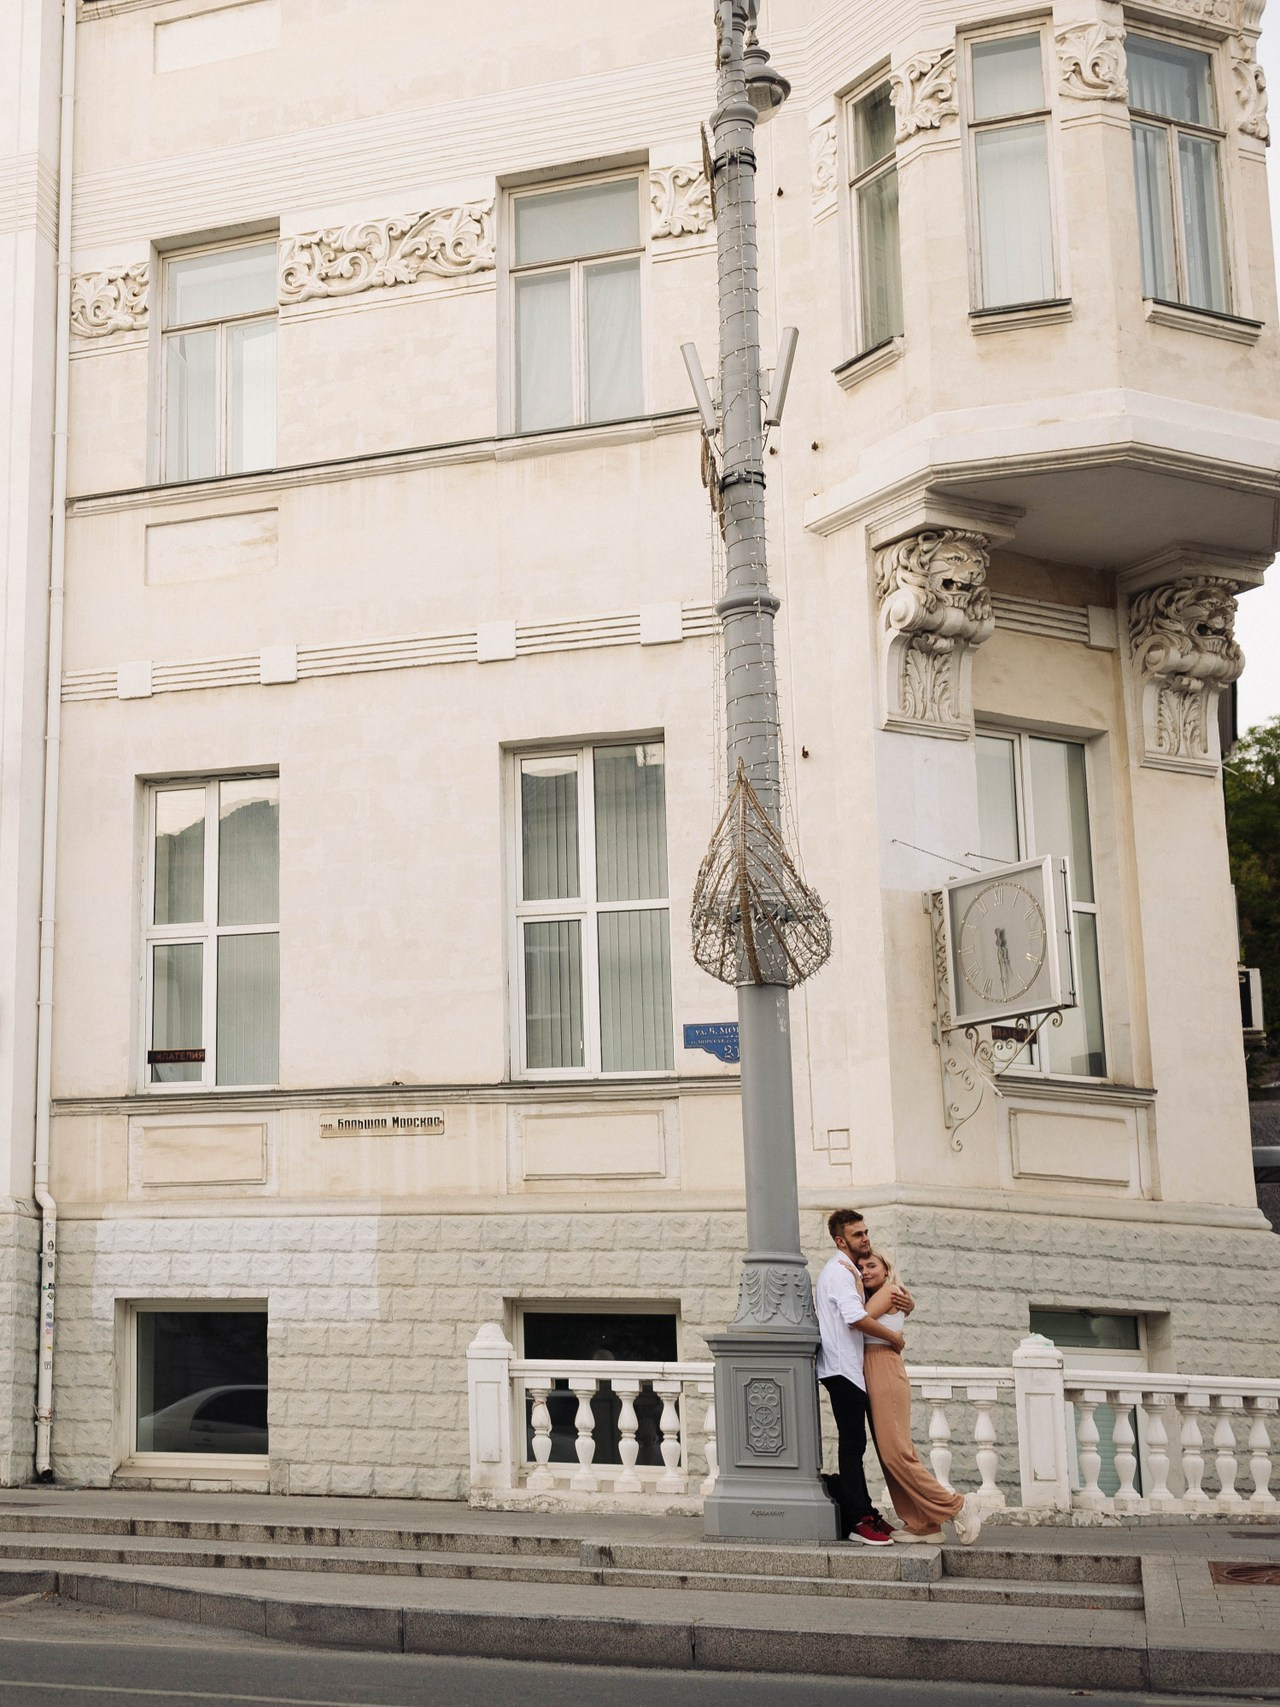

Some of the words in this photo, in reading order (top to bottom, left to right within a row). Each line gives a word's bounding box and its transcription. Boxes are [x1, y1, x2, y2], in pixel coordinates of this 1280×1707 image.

[720, 1026, 739, 1035] МО
[337, 1118, 387, 1131] Большая
[392, 1116, 440, 1128] Морская
